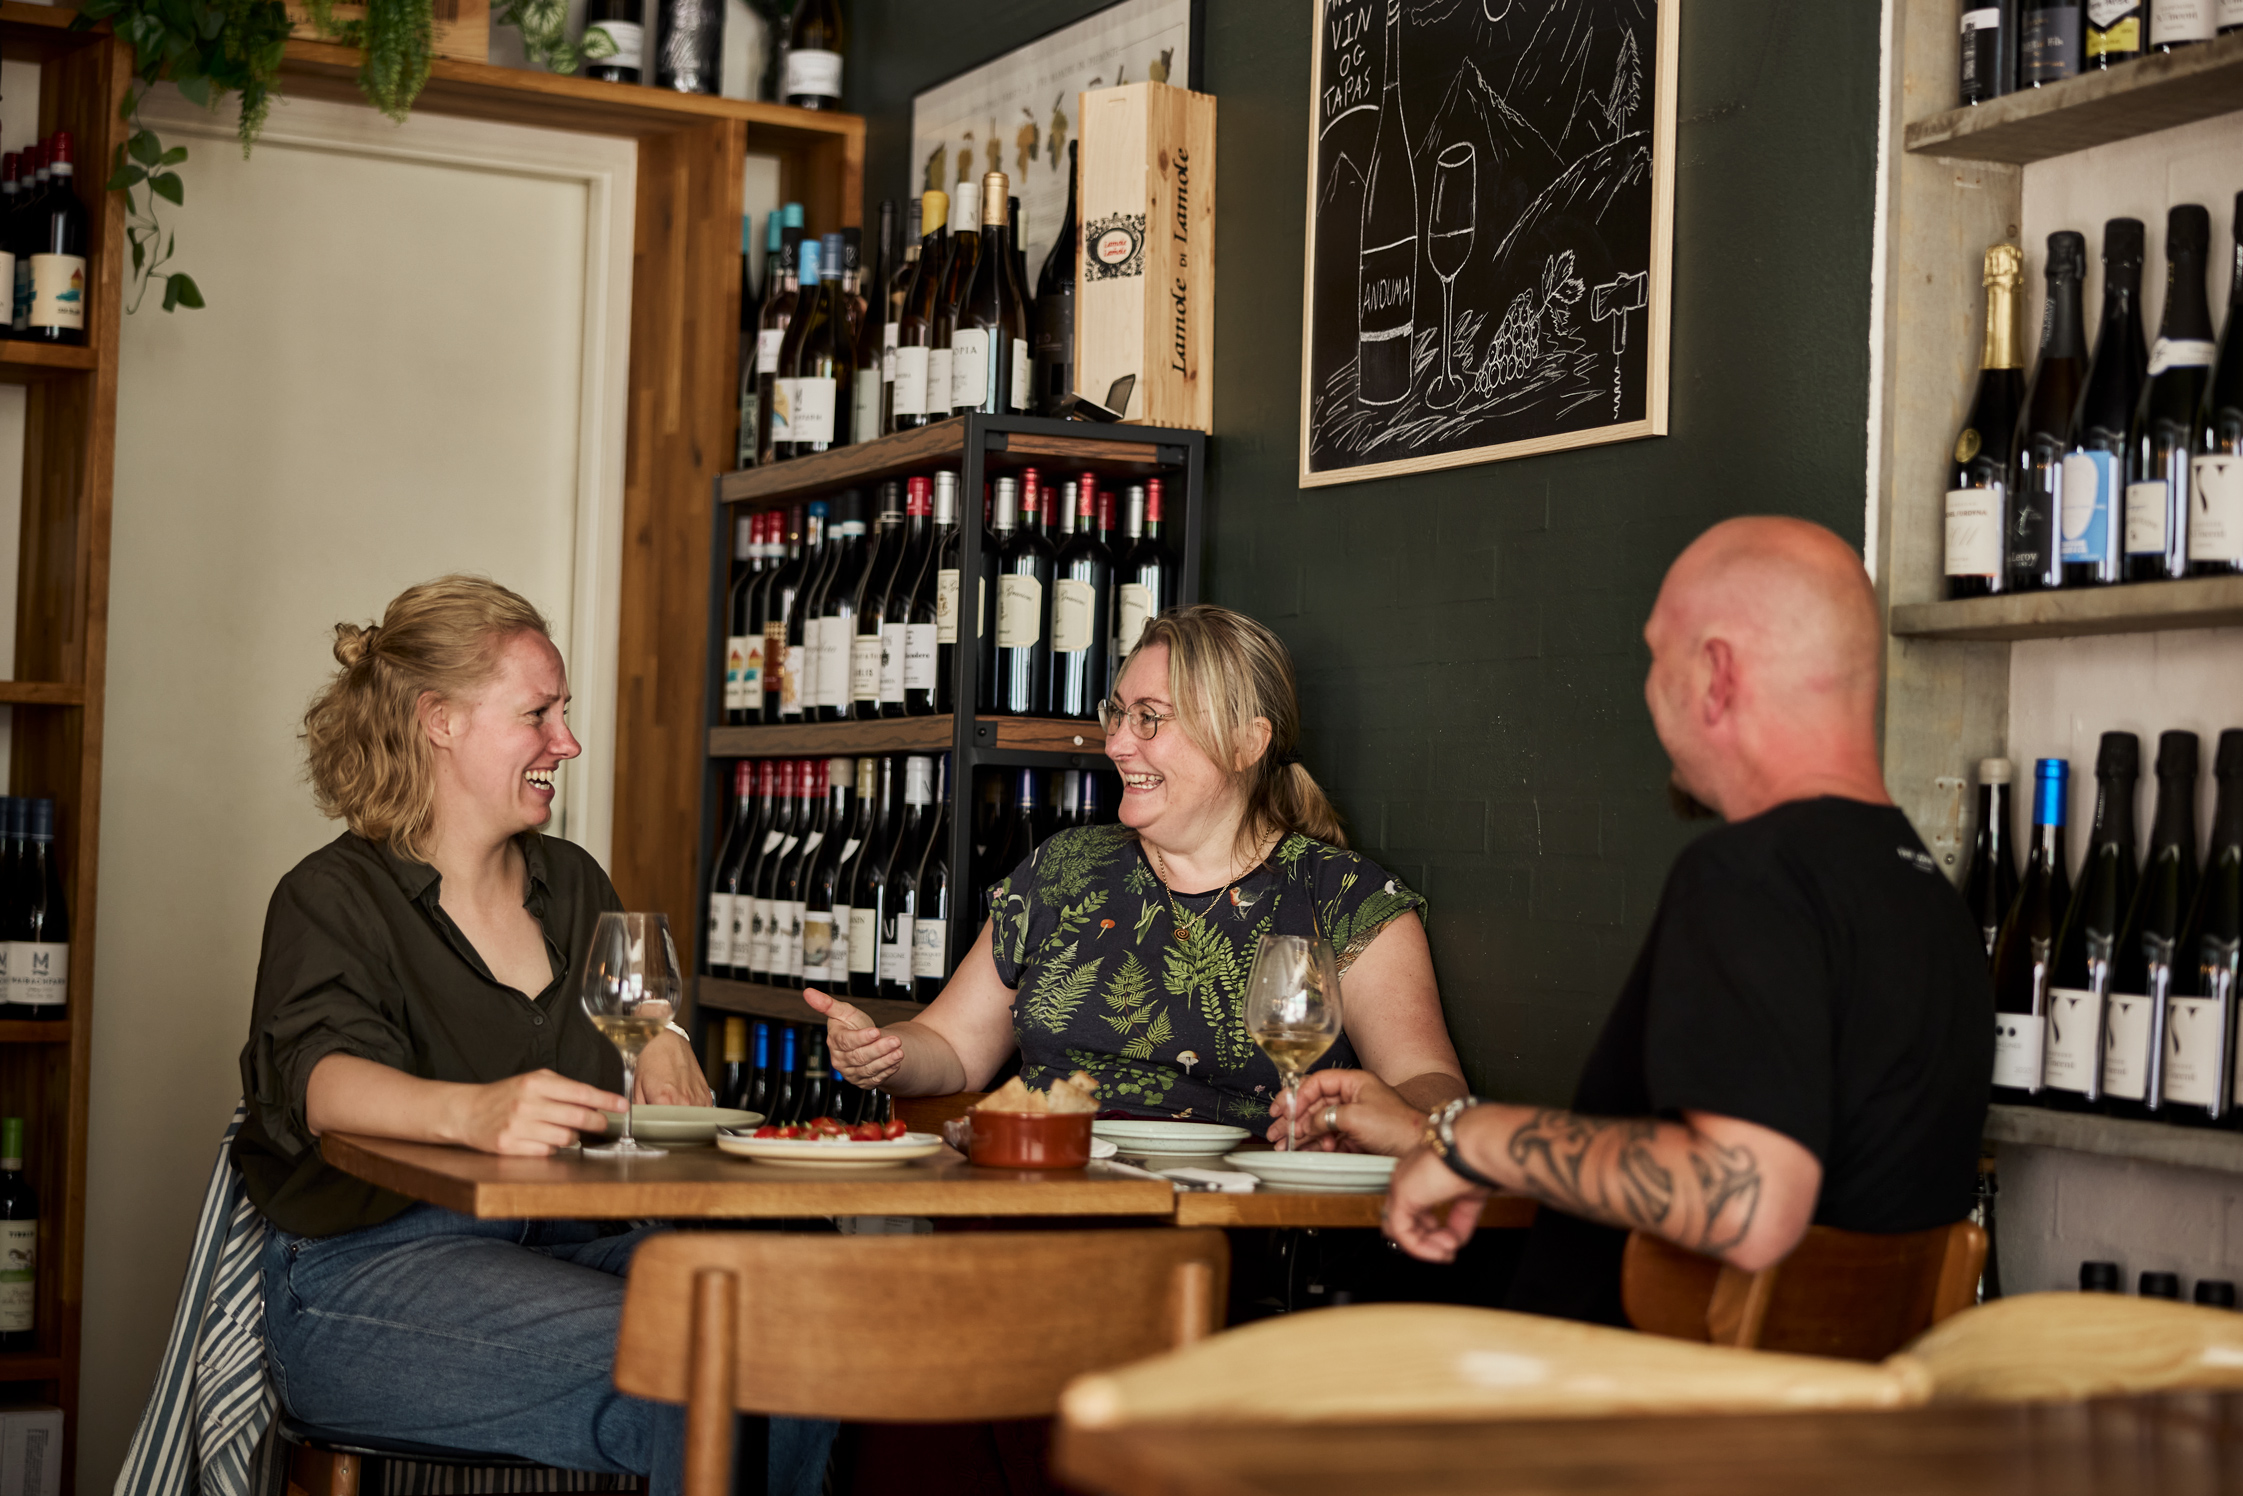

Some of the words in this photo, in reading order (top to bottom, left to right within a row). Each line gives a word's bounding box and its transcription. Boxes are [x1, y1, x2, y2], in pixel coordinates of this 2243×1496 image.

[1332, 4, 1372, 50] VIN
[1340, 44, 1366, 77] OG
[1323, 66, 1371, 117] TAPAS
[1172, 147, 1189, 244] Lamole
[1180, 253, 1188, 268] DI
[1170, 278, 1187, 379] Lamole
[2012, 552, 2038, 567] Leroy
